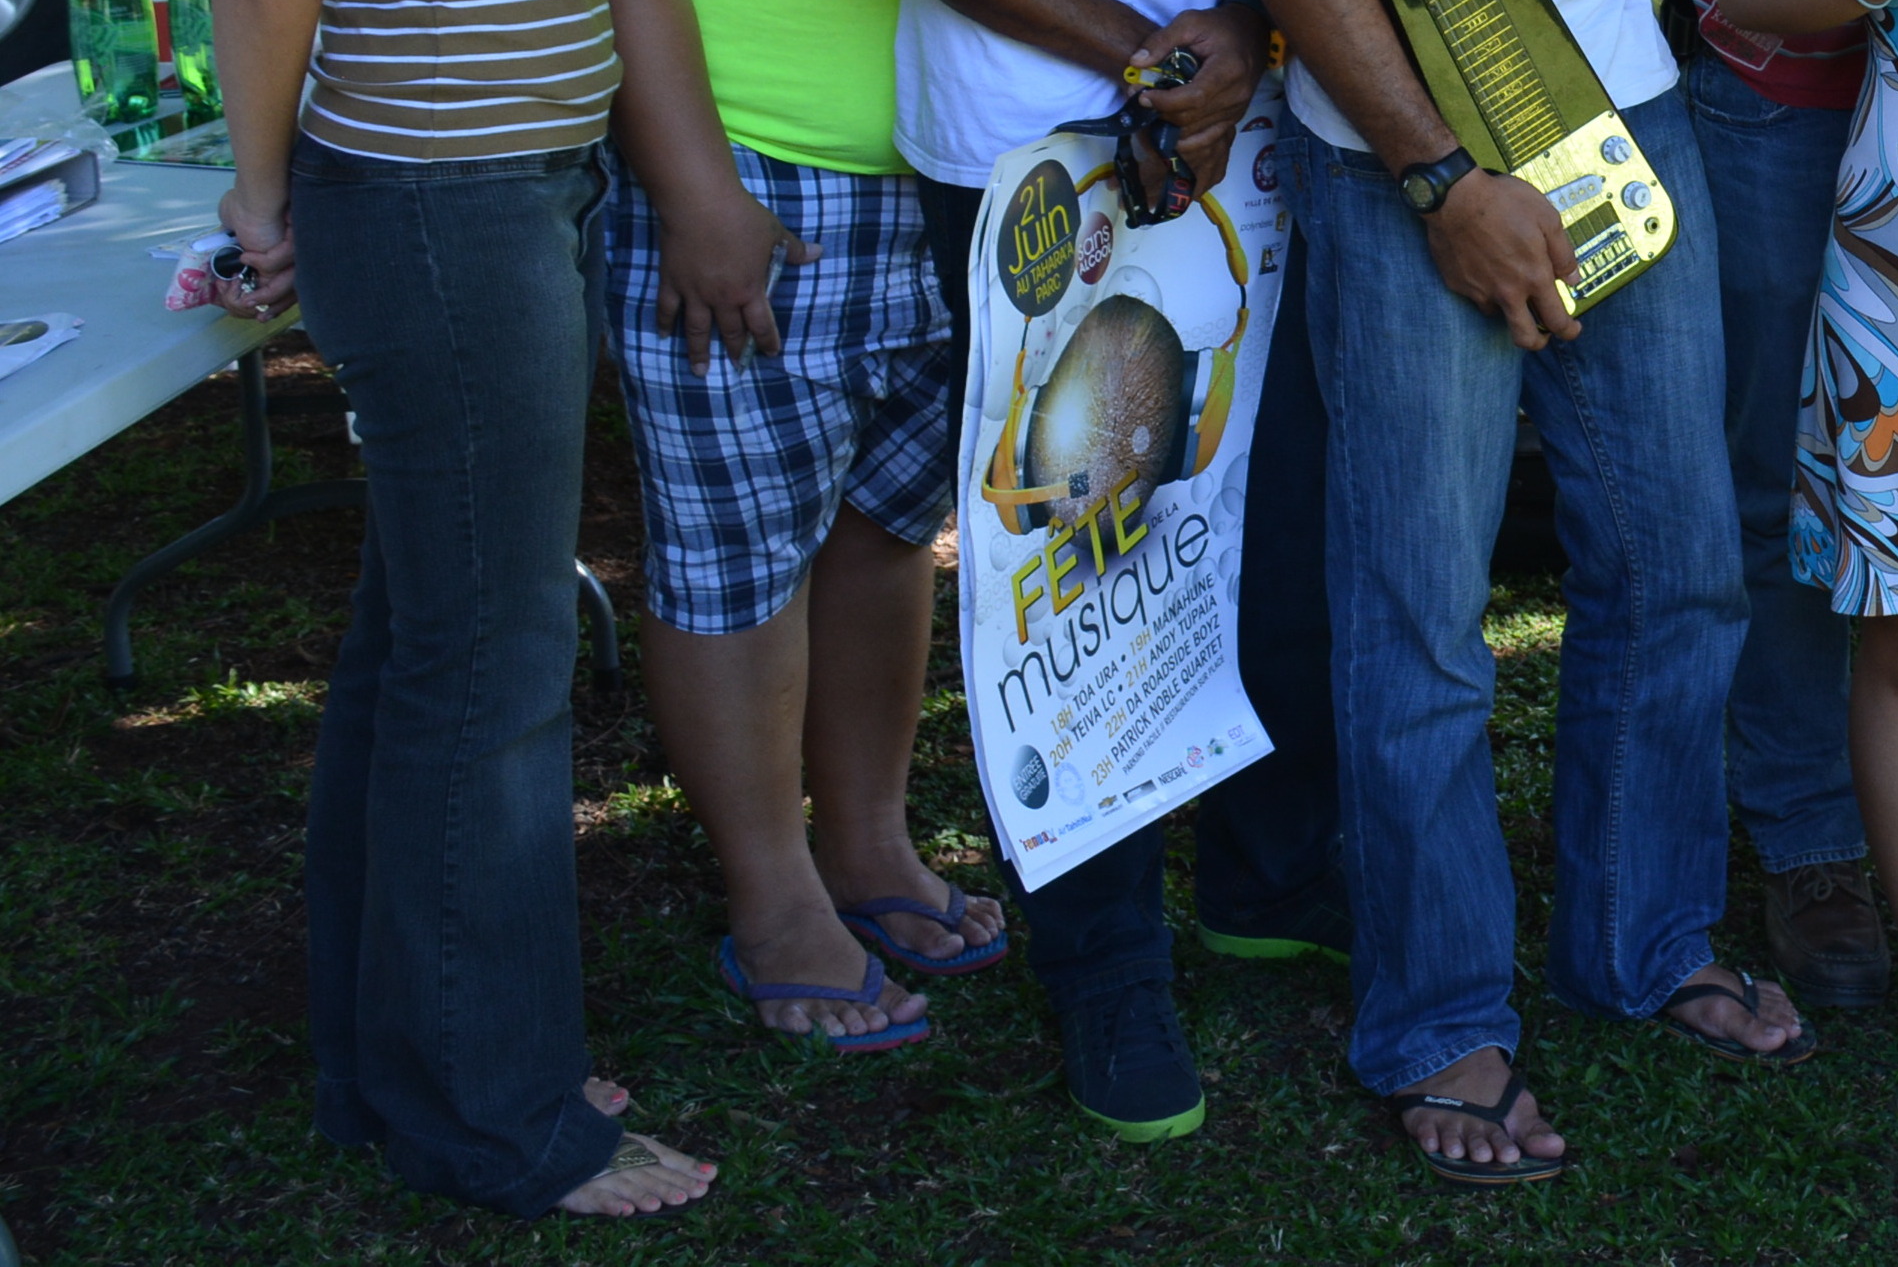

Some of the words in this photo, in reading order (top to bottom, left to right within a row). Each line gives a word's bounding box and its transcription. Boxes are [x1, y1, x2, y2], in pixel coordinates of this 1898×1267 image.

[1019, 176, 1046, 226] 21
[1009, 204, 1070, 275] Juin
[1076, 224, 1110, 261] sans
[1079, 239, 1113, 275] ALCOOL
[1016, 276, 1031, 298] AU
[1035, 273, 1062, 304] PARC
[1151, 513, 1163, 529] DE
[1165, 502, 1179, 520] LA
[1011, 469, 1149, 646] FÊTE
[997, 513, 1209, 733] musique
[1050, 705, 1074, 735] 18H
[1072, 684, 1095, 712] TOA
[1095, 660, 1119, 690] URA
[1129, 628, 1153, 656] 19H
[1152, 572, 1215, 635] MANAHUNE
[1050, 736, 1073, 768] 20H
[1071, 706, 1102, 742] TEIVA
[1102, 690, 1116, 712] LC
[1125, 659, 1149, 687] 21H
[1149, 629, 1176, 665] ANDY
[1178, 594, 1218, 638] TUPAÏA
[1105, 709, 1127, 738] 22H
[1126, 692, 1143, 716] DA
[1143, 642, 1192, 699] ROADSIDE
[1193, 613, 1220, 647] BOYZ
[1091, 754, 1114, 786] 23H
[1110, 711, 1151, 763] PATRICK
[1149, 677, 1182, 719] NOBLE
[1181, 634, 1223, 683] QUARTET
[1122, 743, 1146, 775] PARKING
